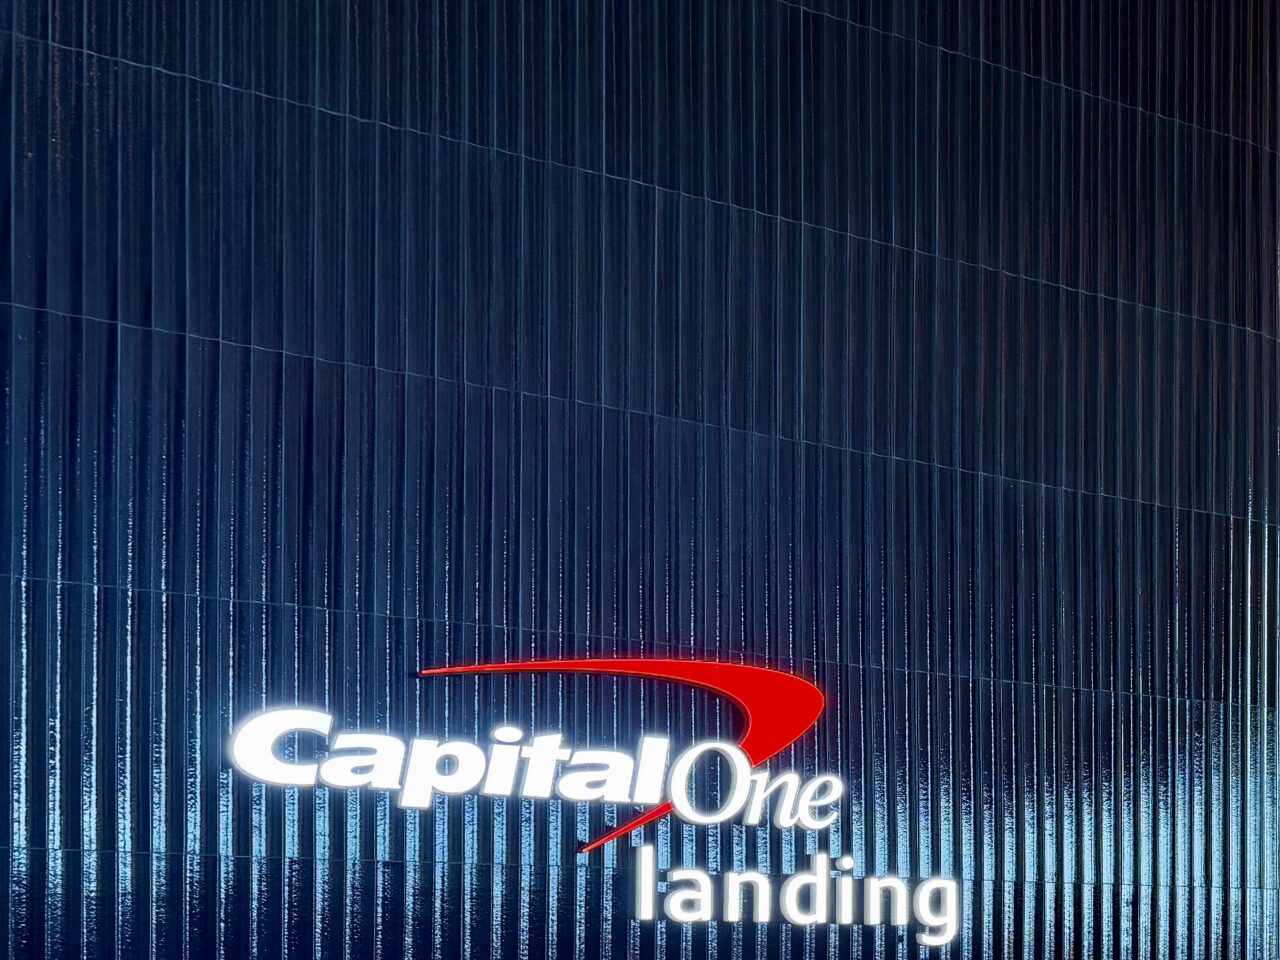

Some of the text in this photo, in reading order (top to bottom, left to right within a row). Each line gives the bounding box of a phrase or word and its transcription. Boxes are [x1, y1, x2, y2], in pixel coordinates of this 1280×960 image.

[229, 708, 844, 829] Capital One
[634, 846, 959, 946] landing
